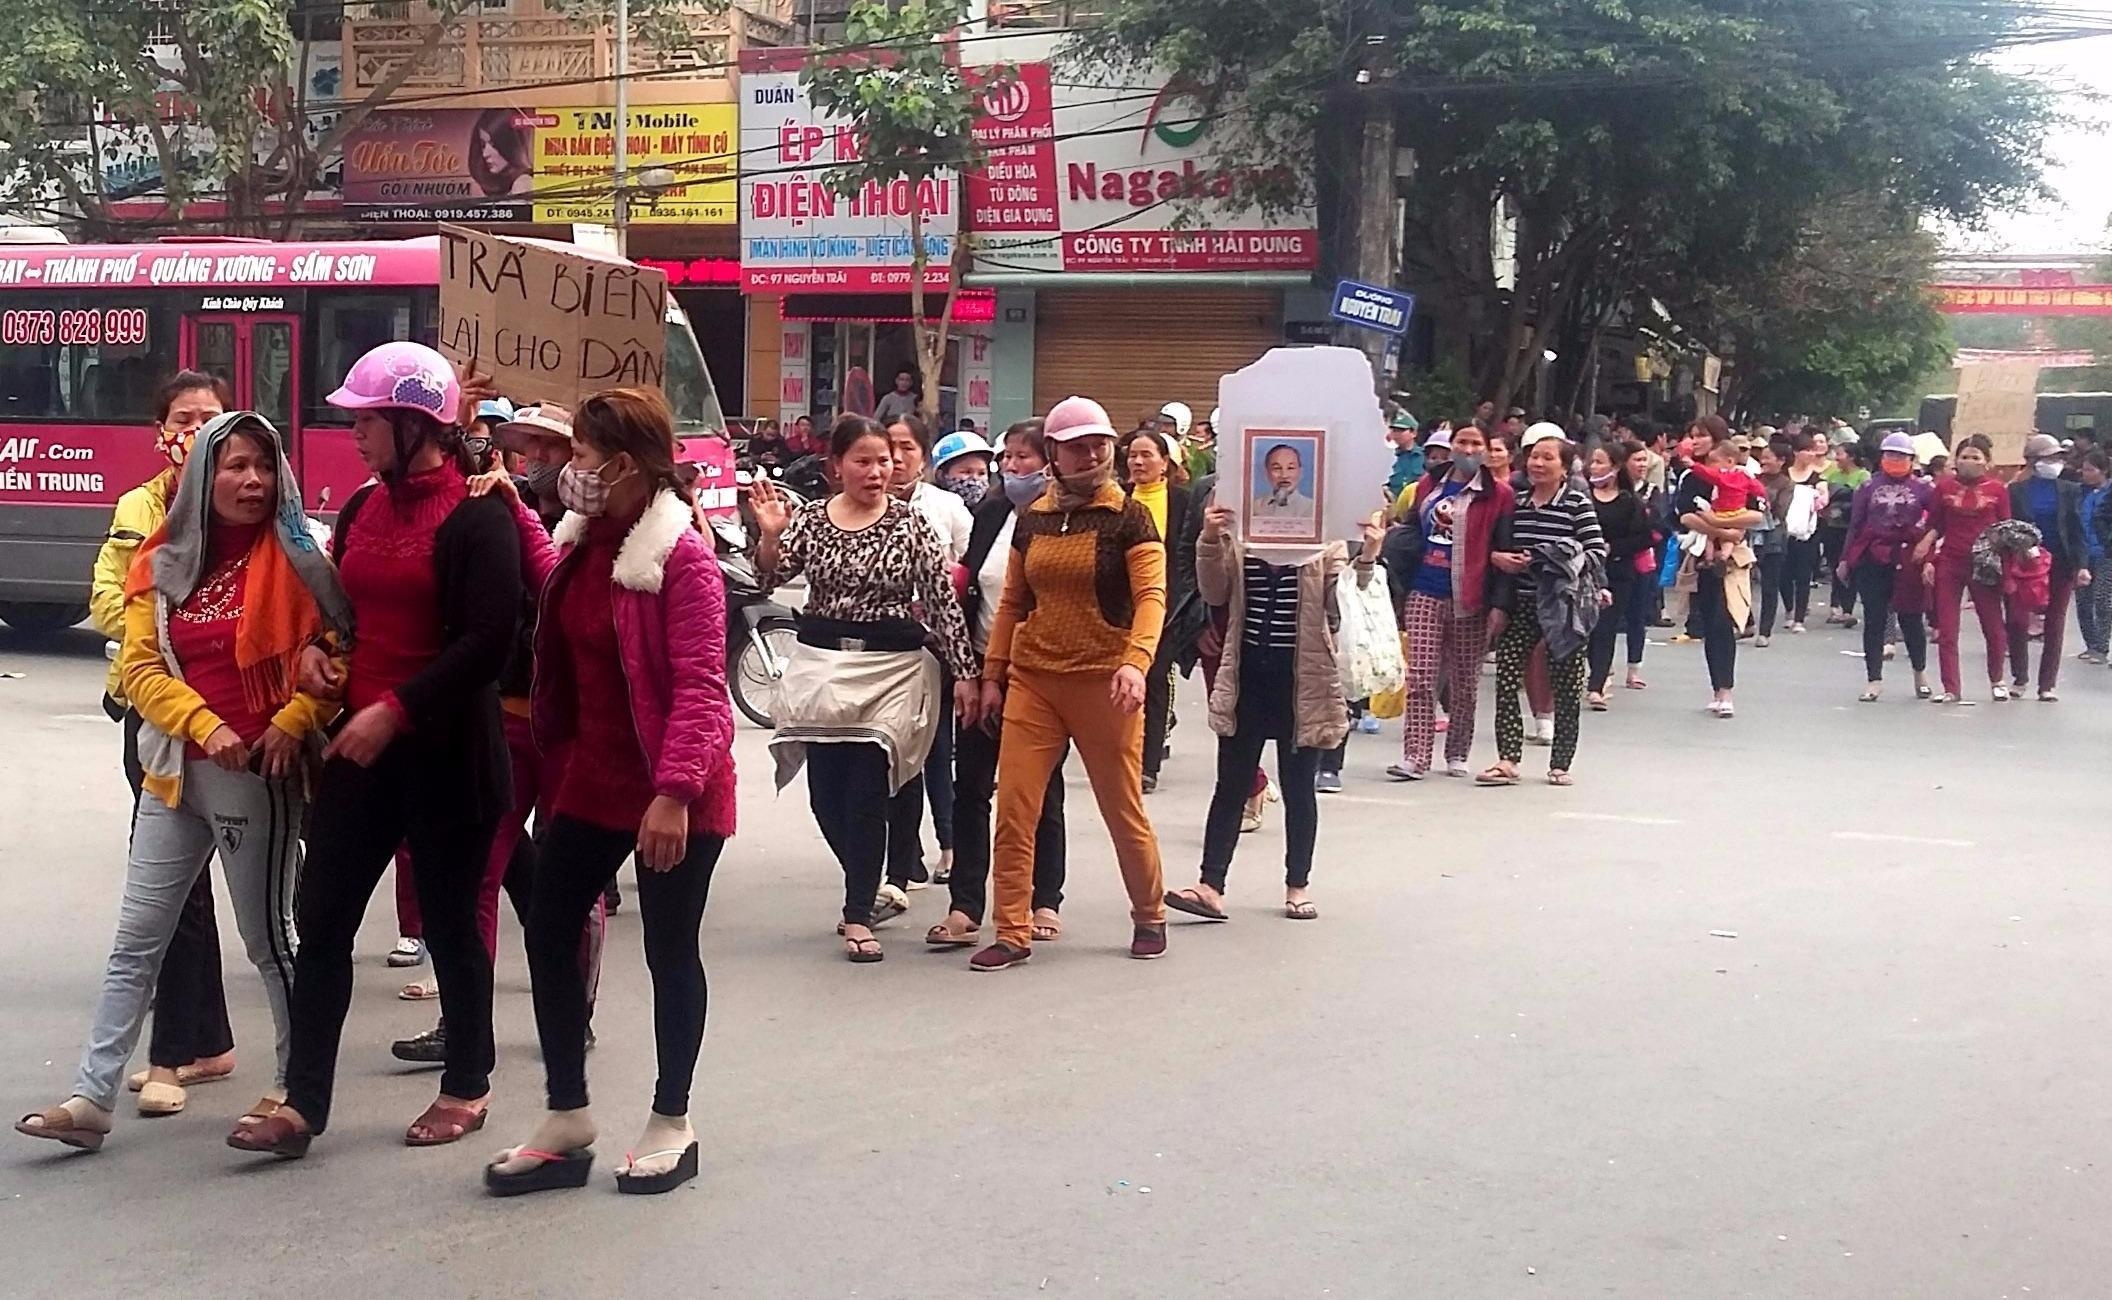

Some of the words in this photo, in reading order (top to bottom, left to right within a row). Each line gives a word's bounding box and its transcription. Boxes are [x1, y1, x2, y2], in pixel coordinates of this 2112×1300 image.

[636, 113, 699, 129] Mobile
[1003, 208, 1022, 223] GIA
[1073, 234, 1123, 254] CÔNG
[1129, 237, 1153, 254] TY
[334, 253, 376, 282] SƠN
[2, 310, 55, 344] 0373
[59, 310, 100, 345] 828
[105, 309, 147, 344] 999
[495, 328, 562, 371] CHO
[581, 337, 663, 388] DÂN
[37, 472, 104, 492] TRUNG
